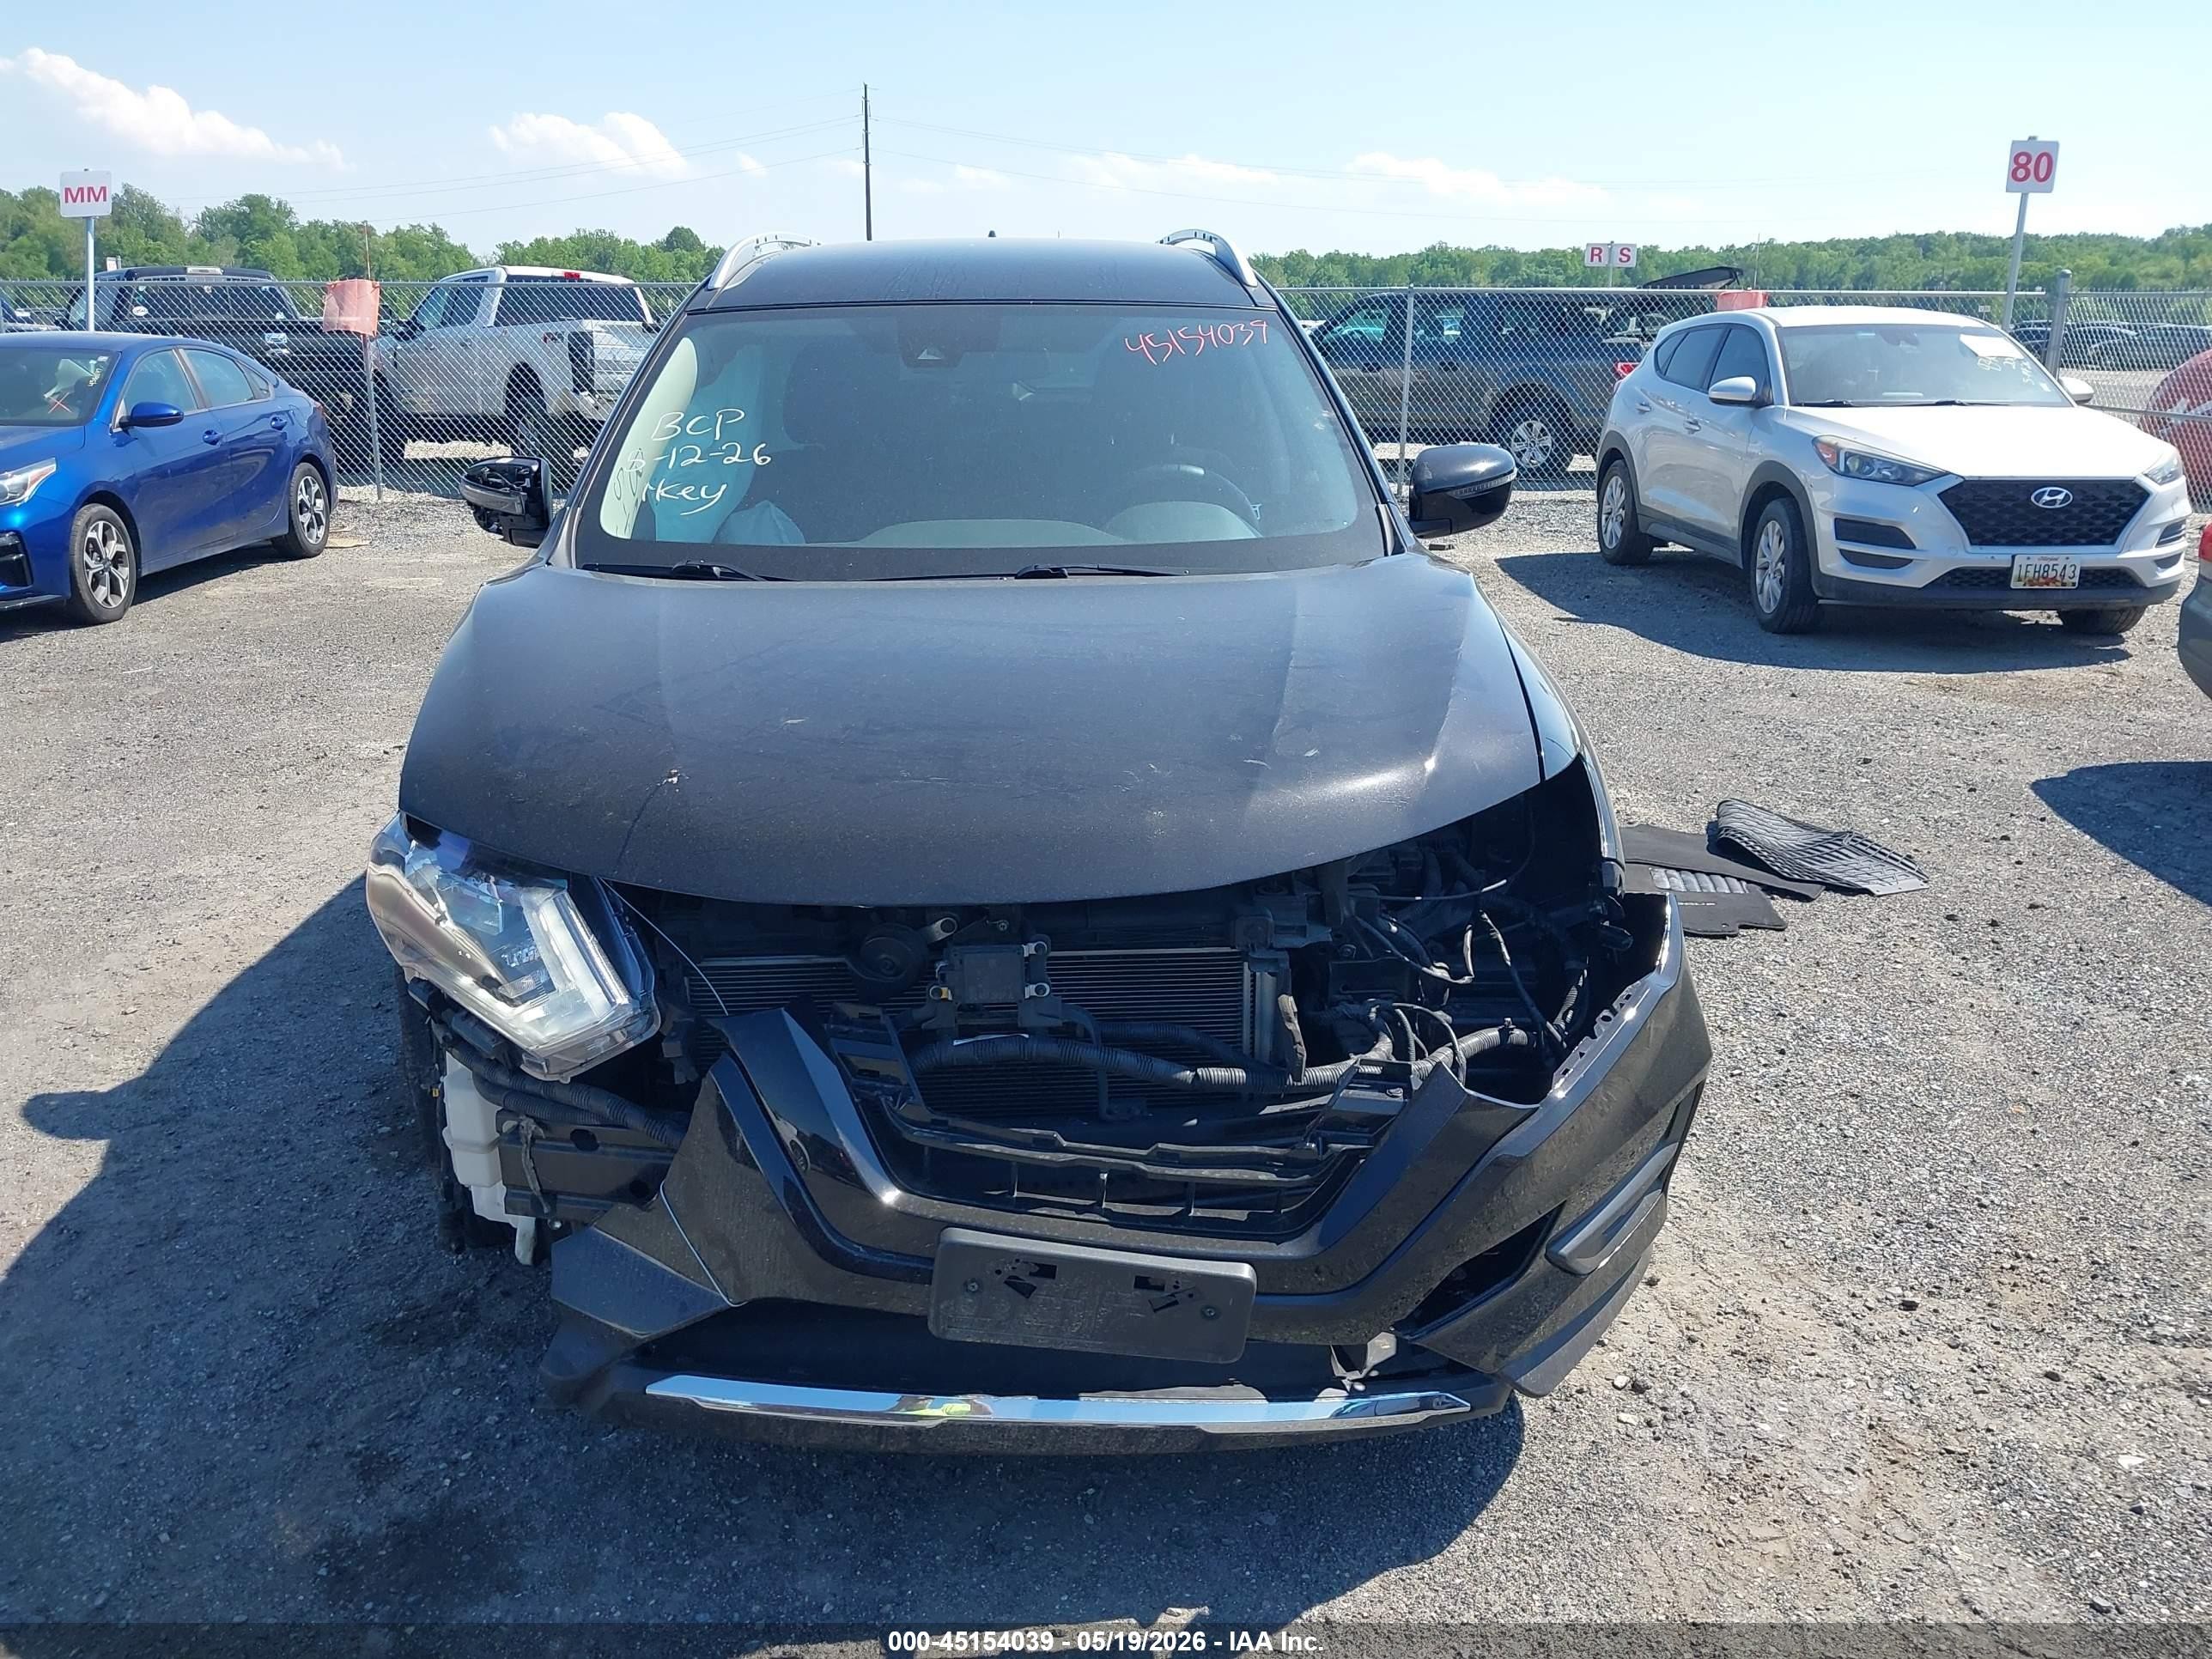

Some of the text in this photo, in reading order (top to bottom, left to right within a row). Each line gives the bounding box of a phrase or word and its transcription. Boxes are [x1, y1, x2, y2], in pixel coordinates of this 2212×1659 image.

[2011, 151, 2054, 183] 80
[64, 185, 107, 204] MM
[1589, 246, 1603, 263] R
[1618, 246, 1632, 263] S
[1124, 319, 1267, 366] 45154039
[651, 408, 745, 441] BCP
